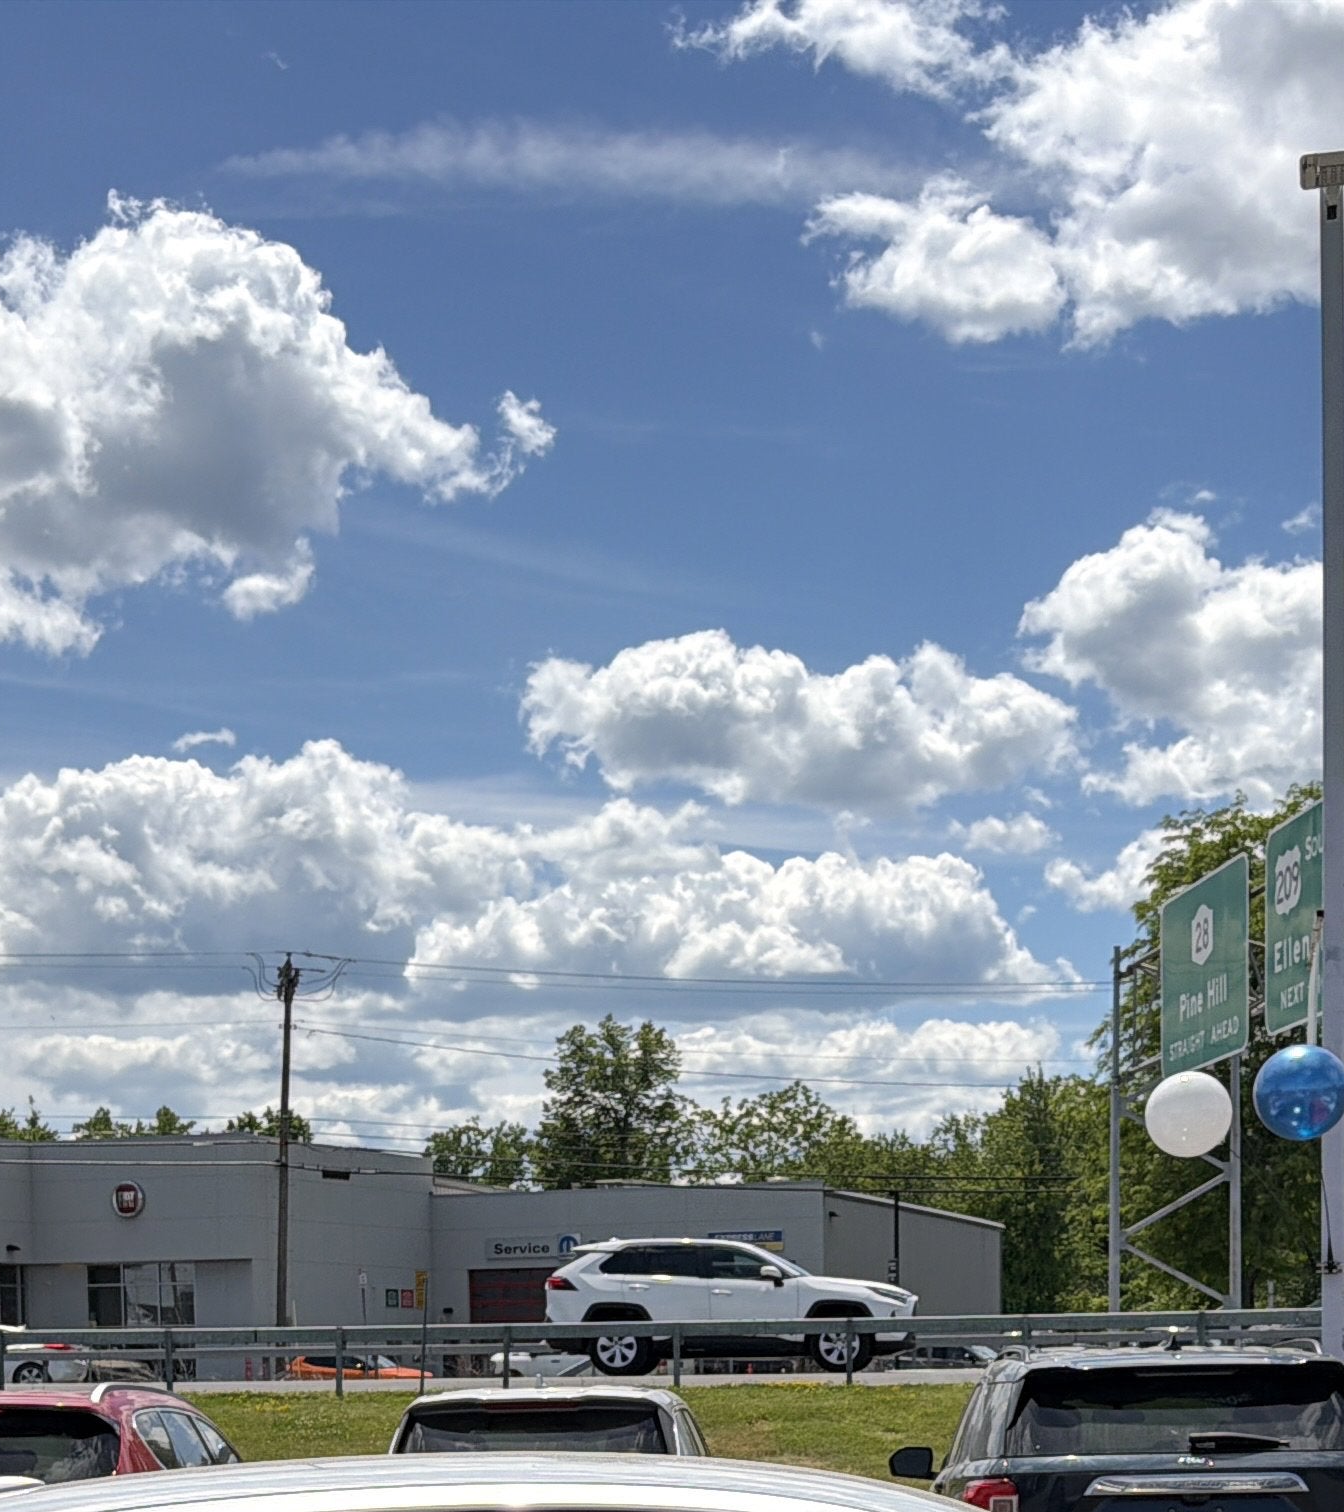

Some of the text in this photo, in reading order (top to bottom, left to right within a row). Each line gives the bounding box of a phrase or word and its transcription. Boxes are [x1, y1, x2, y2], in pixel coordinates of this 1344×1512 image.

[1276, 861, 1300, 905] 209
[1194, 916, 1209, 954] 28
[1273, 935, 1312, 974] Ellen
[1179, 972, 1228, 1022] Pine Hill
[1280, 981, 1305, 1010] NEXT
[1169, 1015, 1240, 1061] STRAIGHT AHEAD
[493, 1242, 550, 1255] Service
